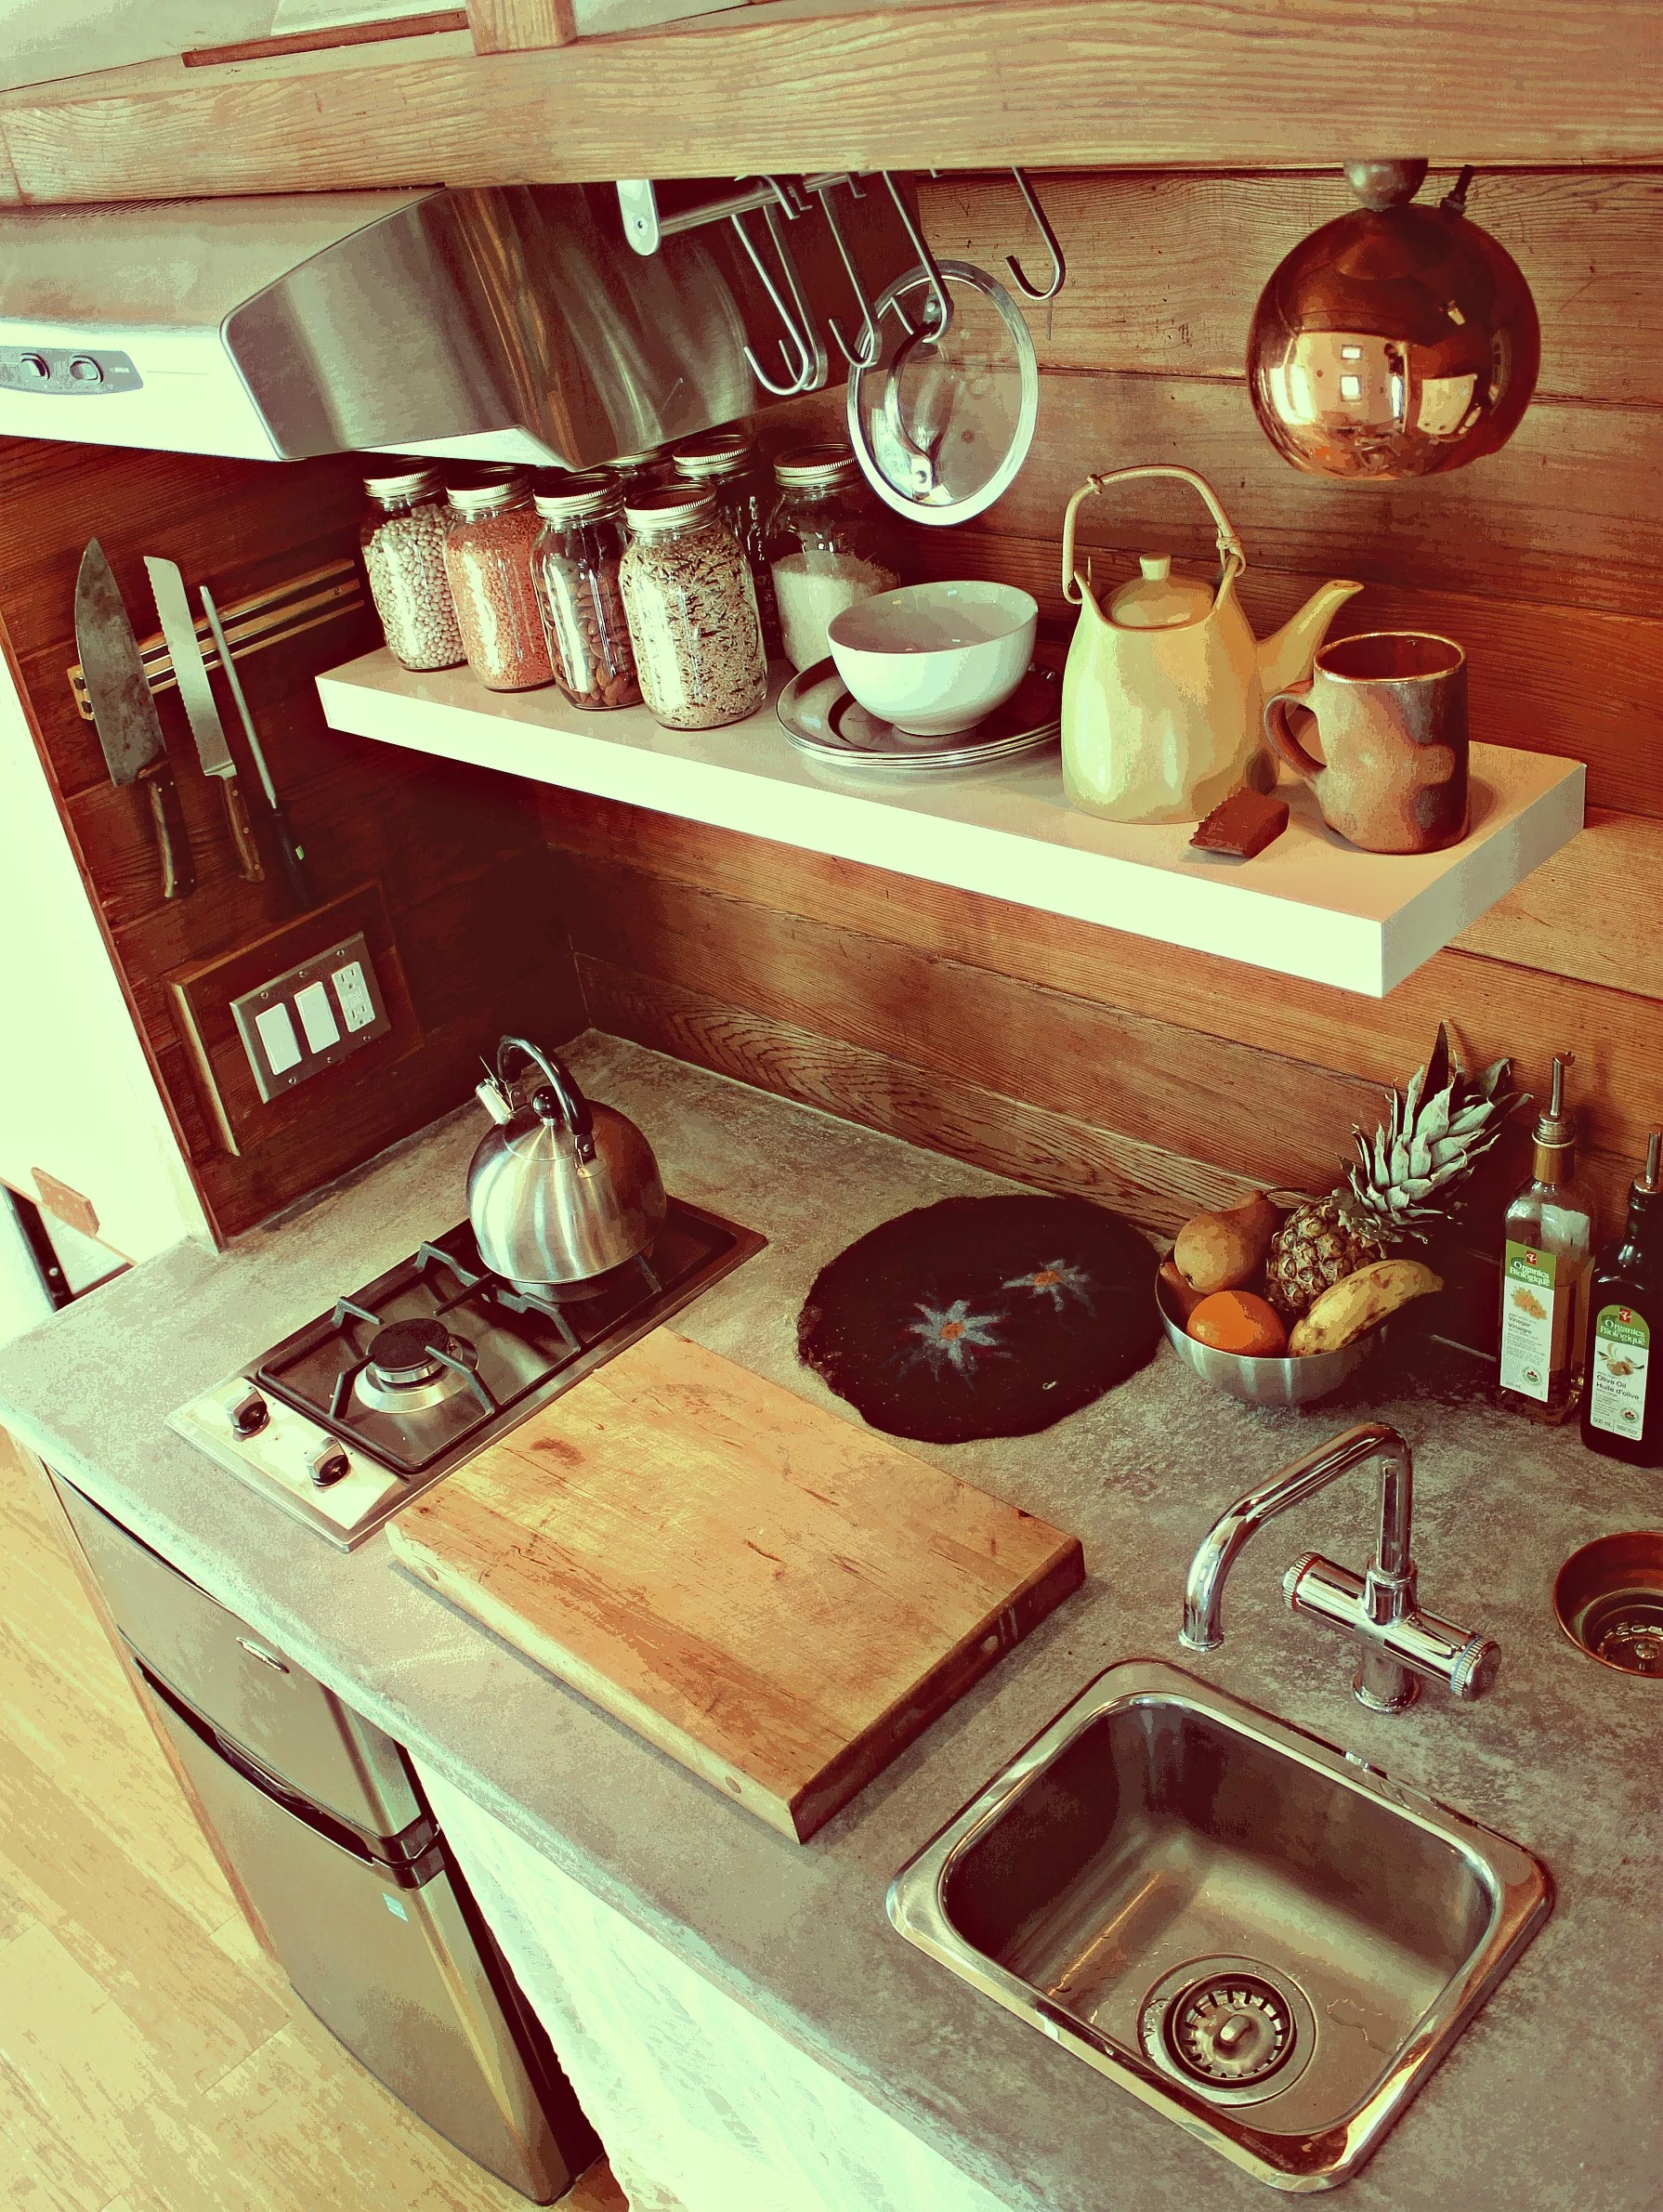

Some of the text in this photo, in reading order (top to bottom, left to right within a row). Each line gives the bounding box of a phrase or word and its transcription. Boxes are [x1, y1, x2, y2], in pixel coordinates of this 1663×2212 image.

[1510, 1267, 1550, 1286] Biologique
[1514, 1262, 1549, 1278] Organics
[1508, 1315, 1531, 1328] Vinegar
[1508, 1322, 1532, 1334] Vinaigre
[1605, 1319, 1645, 1338] Organics
[1600, 1325, 1646, 1345] Biologique
[1596, 1374, 1615, 1385] Olive
[1596, 1381, 1615, 1393] Huile
[1616, 1389, 1640, 1400] d'olive
